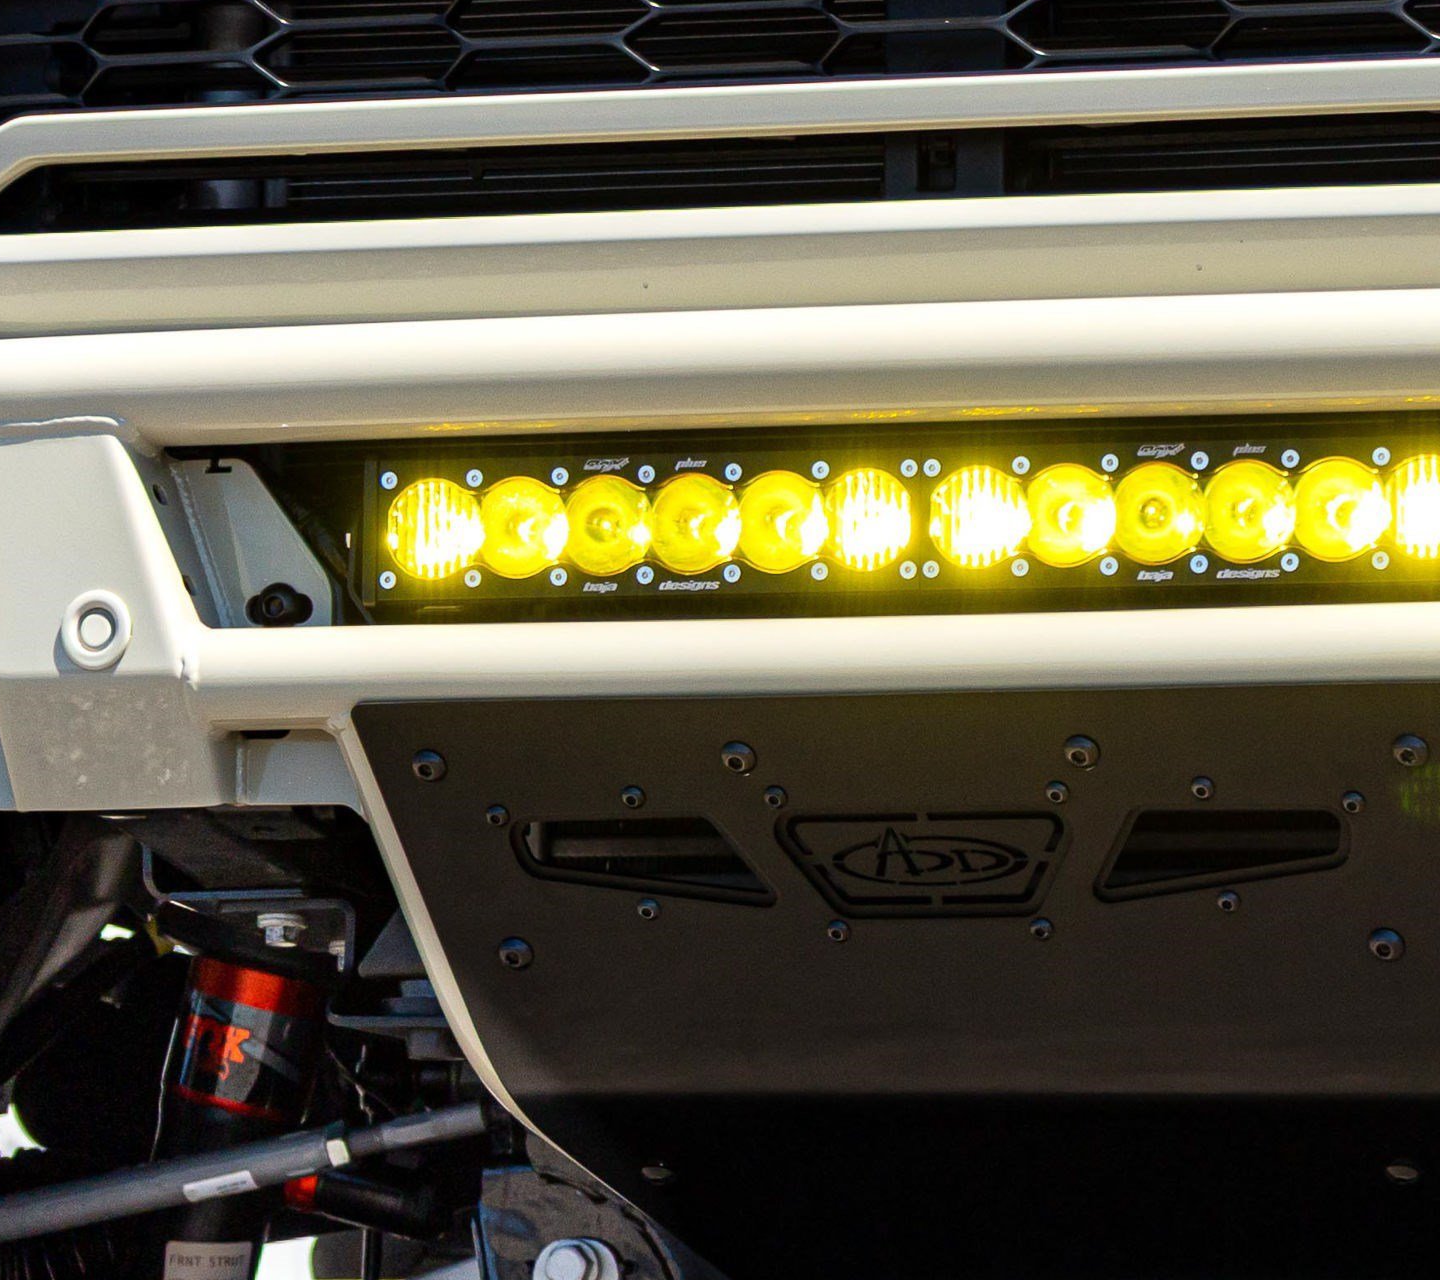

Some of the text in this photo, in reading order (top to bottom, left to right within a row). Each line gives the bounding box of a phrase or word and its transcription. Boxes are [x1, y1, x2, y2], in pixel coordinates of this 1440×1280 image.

[1137, 568, 1281, 582] baja designs
[583, 579, 720, 593] baja designs
